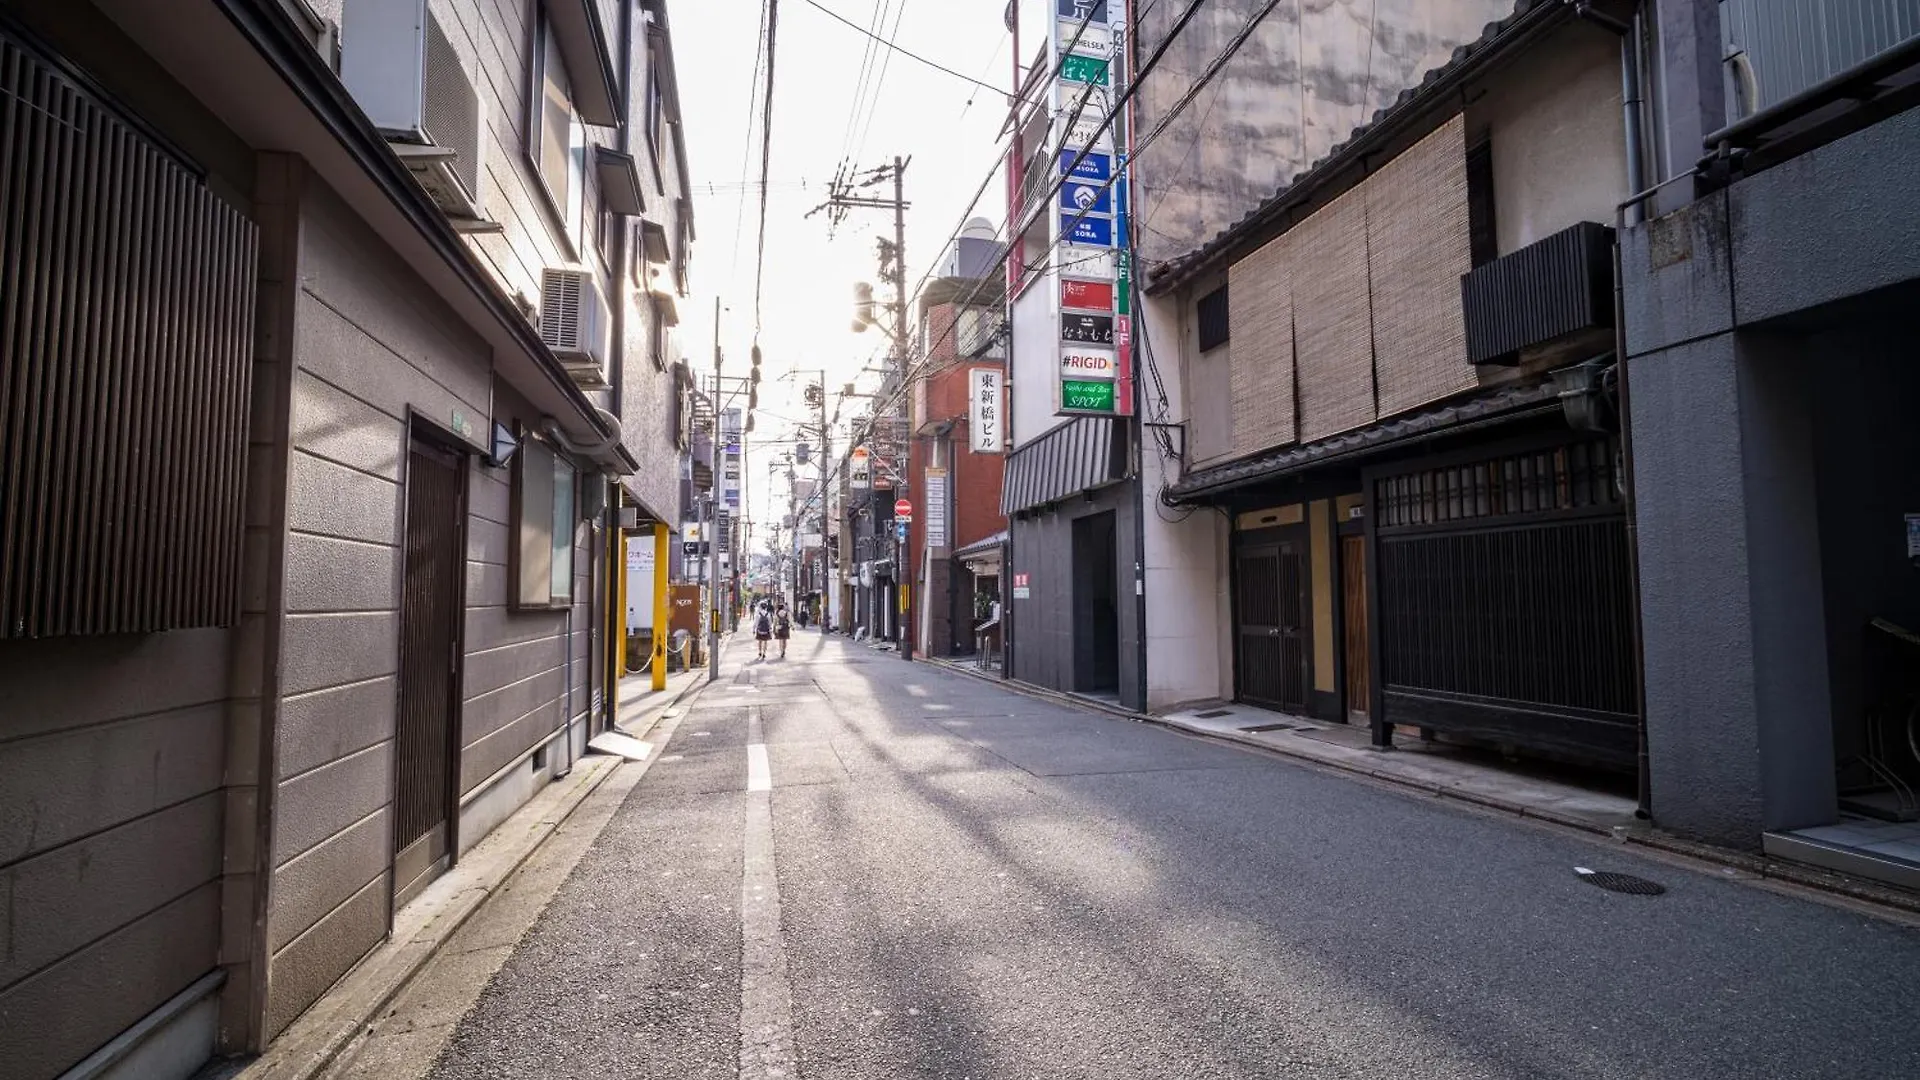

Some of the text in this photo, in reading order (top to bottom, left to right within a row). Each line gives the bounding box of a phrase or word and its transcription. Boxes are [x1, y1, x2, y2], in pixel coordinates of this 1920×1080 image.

[1071, 40, 1105, 50] HELSEA
[981, 374, 994, 448] 東新橋ビル
